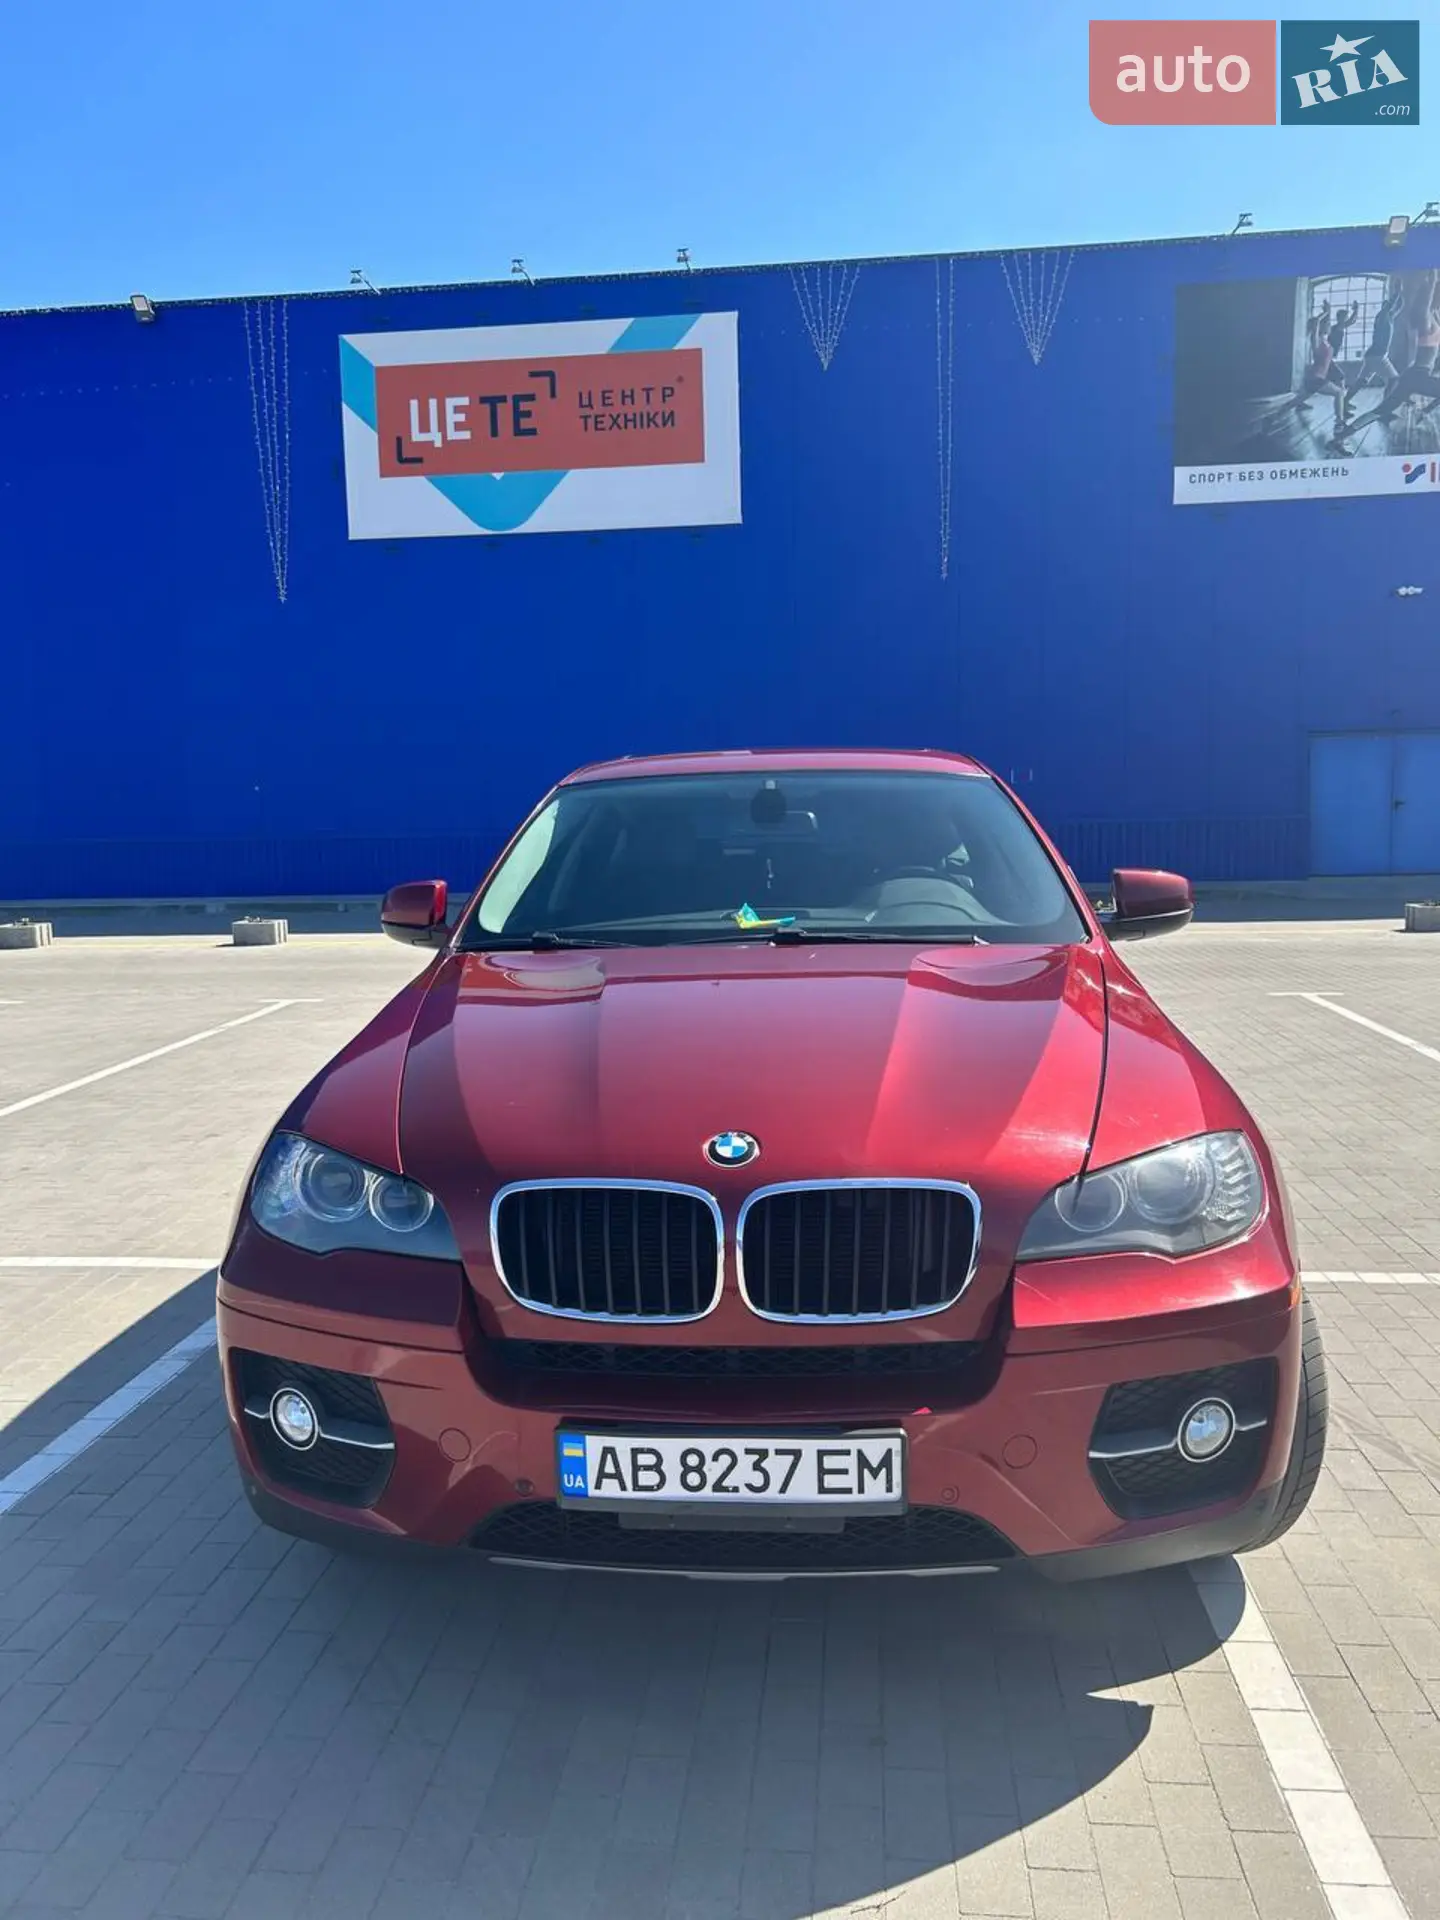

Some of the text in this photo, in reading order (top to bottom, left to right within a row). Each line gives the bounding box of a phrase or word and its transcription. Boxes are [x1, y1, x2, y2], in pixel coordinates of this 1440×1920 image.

[578, 386, 676, 409] ЦЕНТР
[579, 410, 676, 432] ТЕХНІКИ
[1188, 466, 1349, 484] СПОРТ БЕЗ ОБМЕЖЕНЬ
[564, 1473, 586, 1489] UA
[594, 1446, 894, 1495] AB 8237 EM
